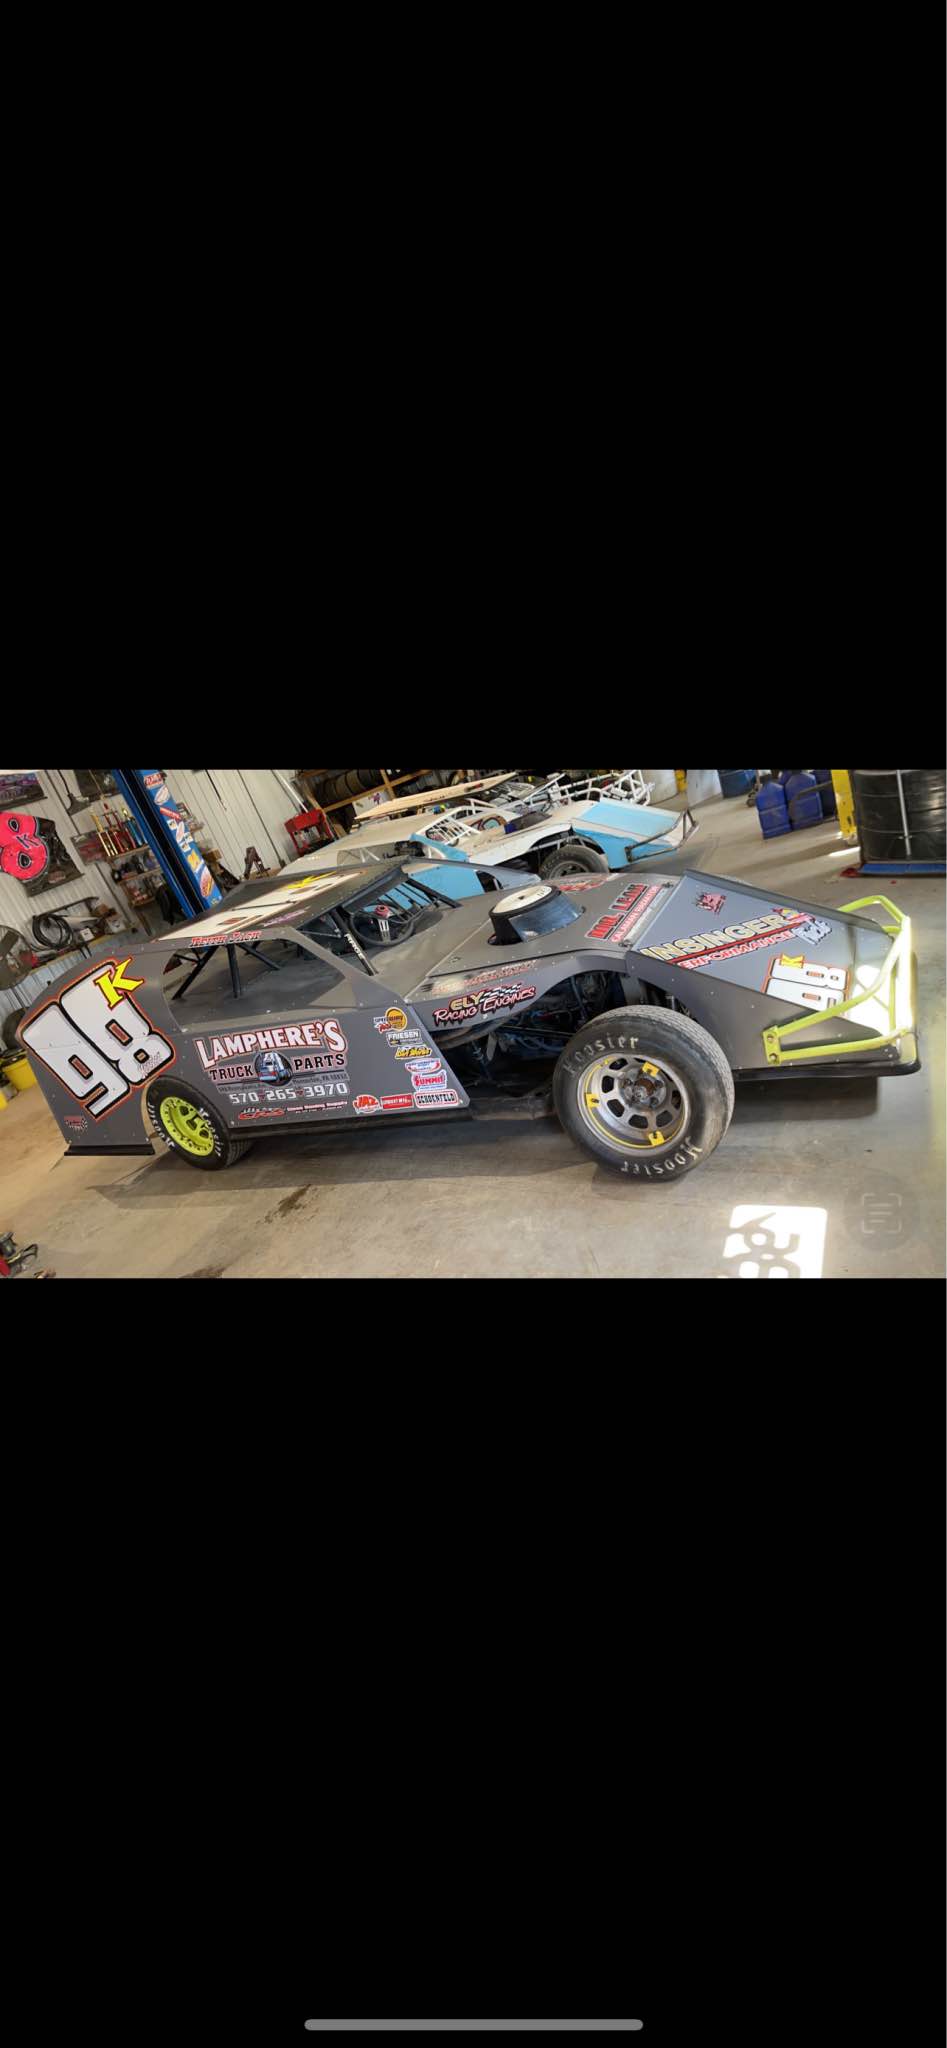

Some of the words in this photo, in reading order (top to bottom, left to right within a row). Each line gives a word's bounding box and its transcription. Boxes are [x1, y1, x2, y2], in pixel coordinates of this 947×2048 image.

[640, 912, 787, 960] INSINGER
[677, 929, 796, 969] ERFORMANCE
[93, 957, 144, 1010] K
[450, 990, 484, 1011] ELY
[433, 1007, 478, 1025] RACING
[482, 986, 536, 1012] ENGINES
[16, 957, 177, 1122] 98
[195, 1020, 347, 1069] LAMPHERE'S
[388, 1031, 419, 1040] FRIESEN
[562, 1033, 639, 1077] Hoosier
[210, 1065, 254, 1081] TRUCK
[294, 1053, 346, 1071] PARTS
[414, 1074, 444, 1087] SUMMIT
[229, 1092, 260, 1105] 570
[266, 1088, 298, 1101] 265
[303, 1083, 348, 1097] 3970
[417, 1092, 455, 1104] SCHOENFELD
[620, 1136, 704, 1178] Hoosier
